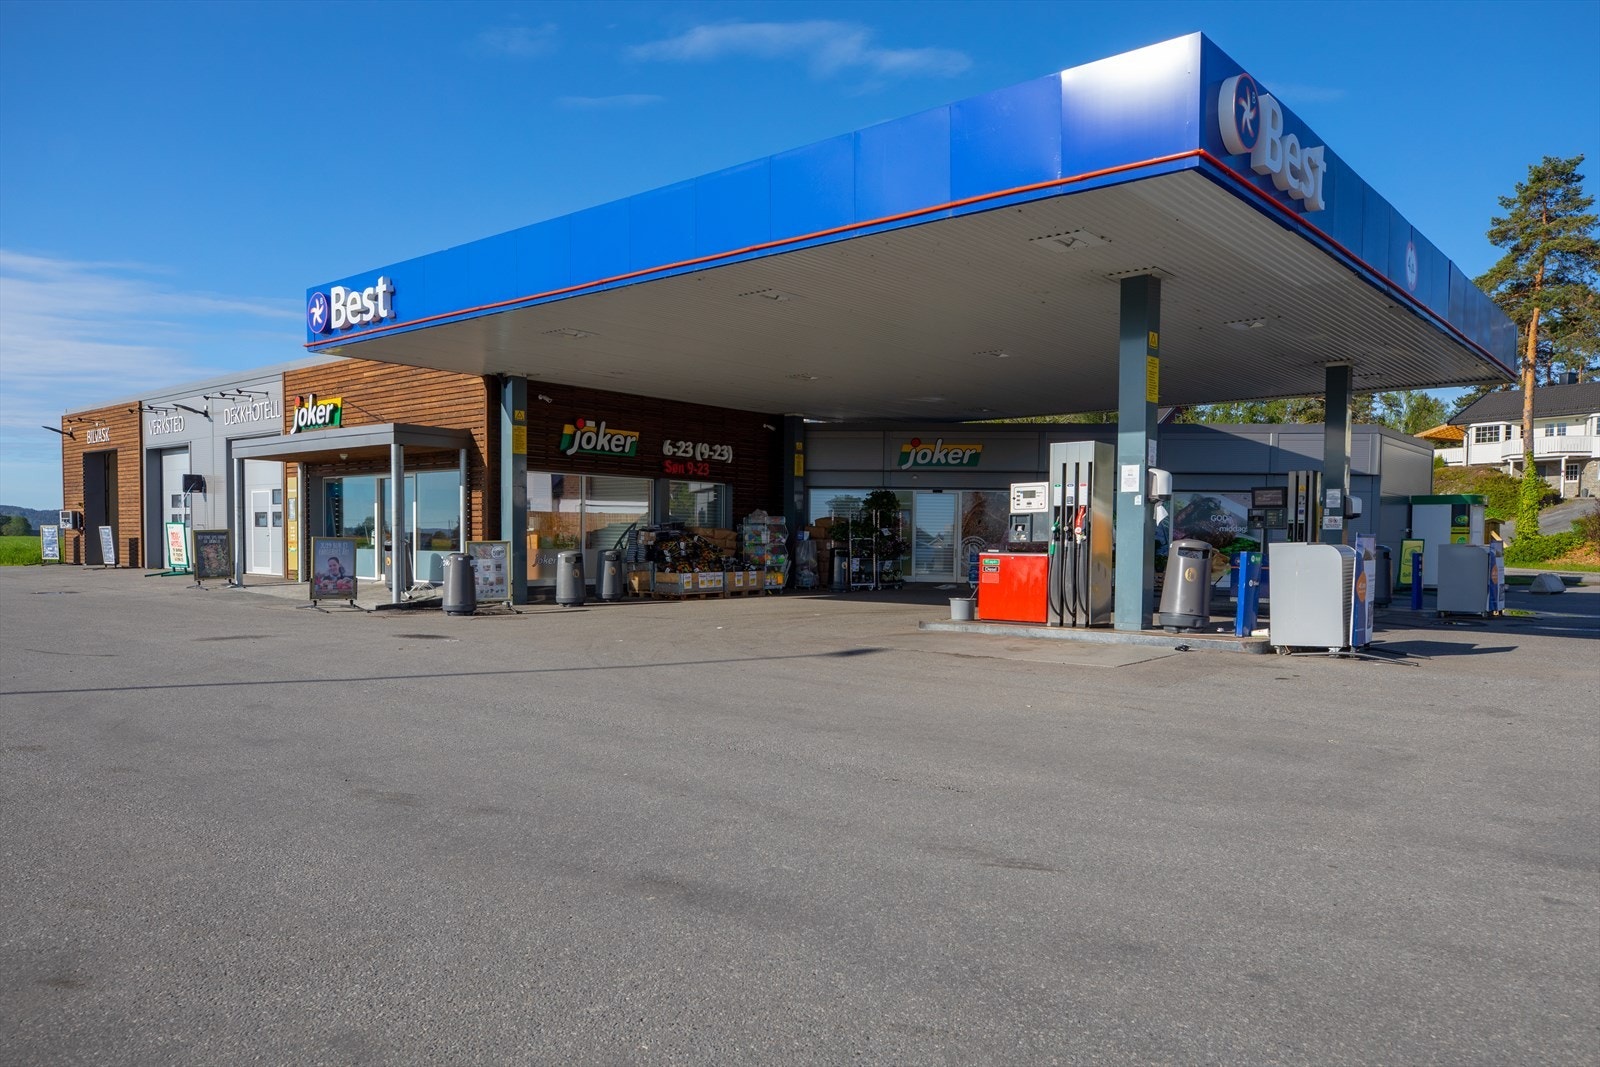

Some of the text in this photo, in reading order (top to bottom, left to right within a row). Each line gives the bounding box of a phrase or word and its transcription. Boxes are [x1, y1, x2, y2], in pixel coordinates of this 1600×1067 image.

[1255, 92, 1326, 211] Best
[330, 276, 393, 329] Best
[148, 415, 185, 436] VERKSTED
[223, 399, 282, 426] DEKKHOTELL
[290, 394, 334, 435] joker
[86, 427, 110, 444] BILVASK
[566, 418, 637, 456] joker
[662, 439, 733, 464] 6-23 (9-23)
[901, 438, 977, 470] joker
[663, 460, 710, 476] Søn 9-23
